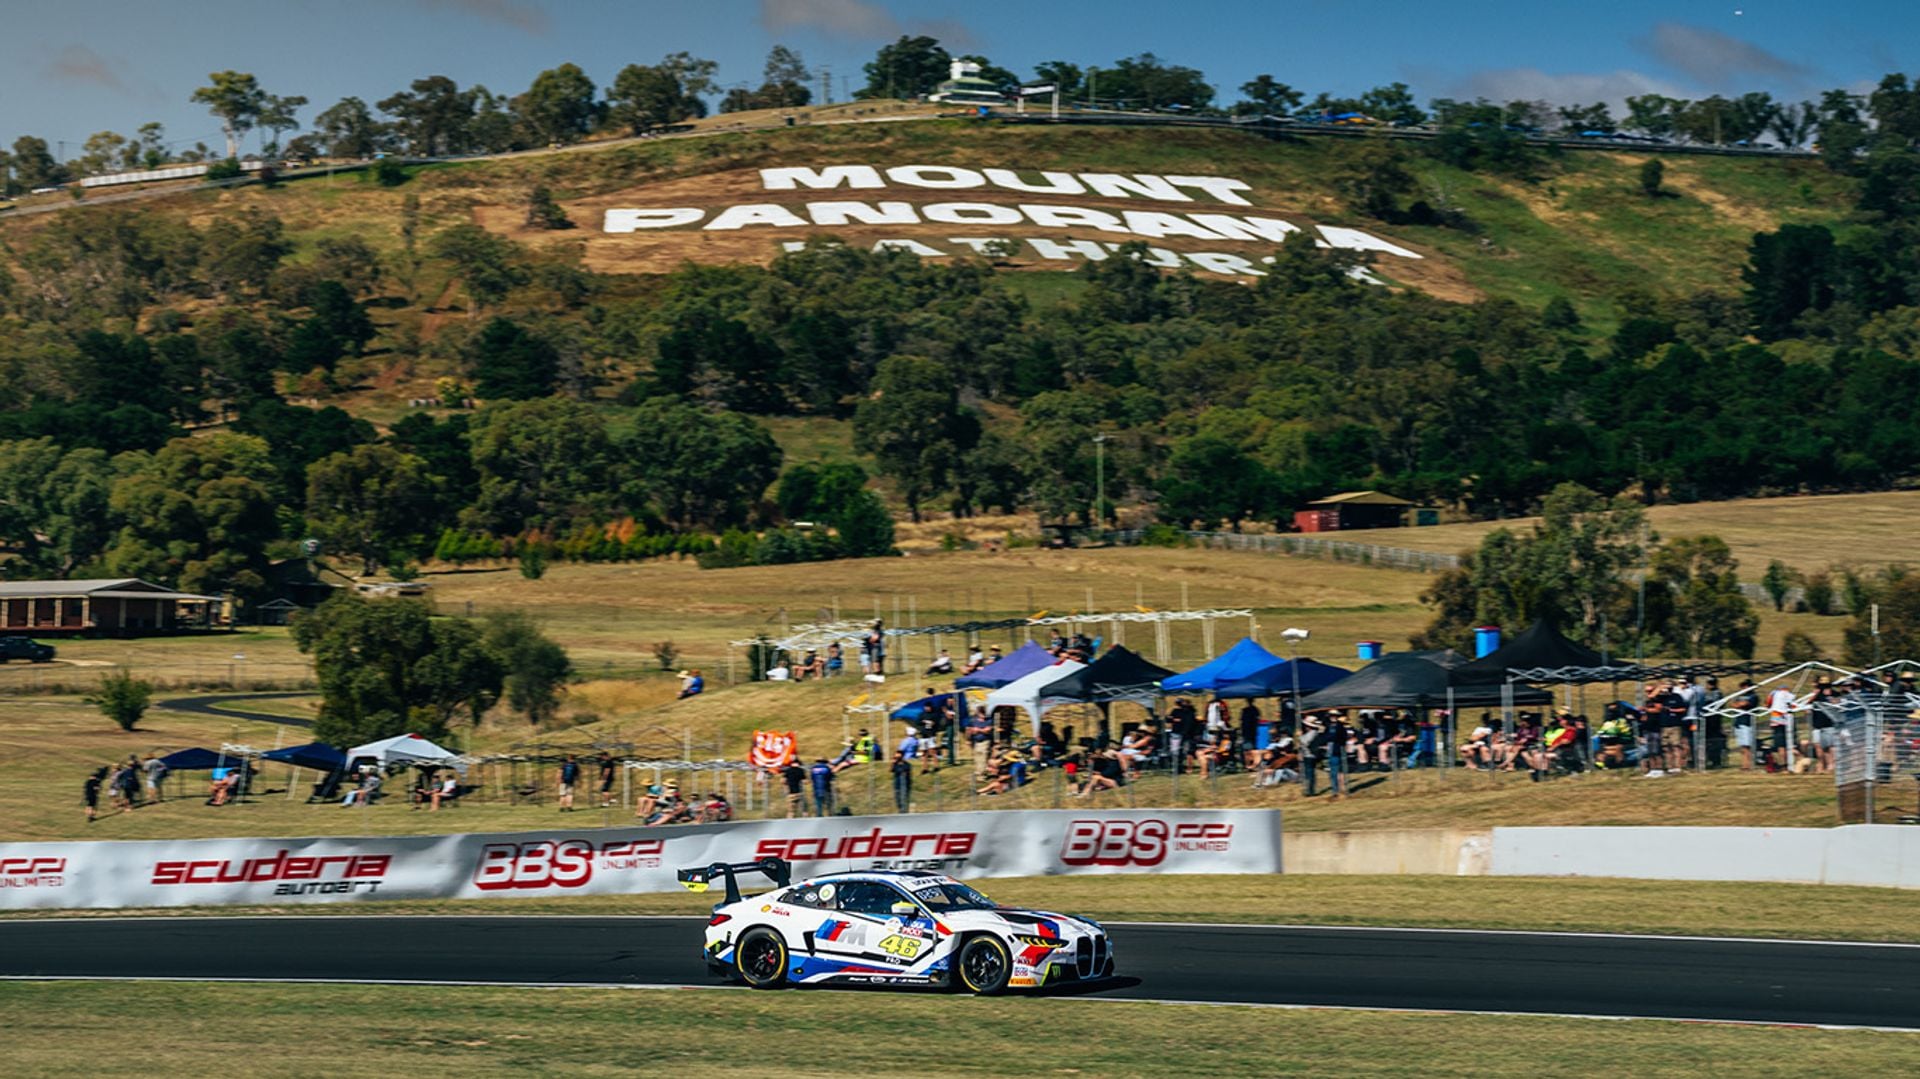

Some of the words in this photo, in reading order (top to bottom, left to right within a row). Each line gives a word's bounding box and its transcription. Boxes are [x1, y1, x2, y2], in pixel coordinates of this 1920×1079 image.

[759, 165, 1254, 206] MOUNT
[603, 201, 1424, 259] PANORAMA
[754, 828, 978, 861] scuderia
[1061, 819, 1169, 866] BBS
[1173, 841, 1230, 851] UNLIMITED
[151, 850, 393, 884] scuderia
[473, 839, 594, 890] BBS
[602, 857, 661, 869] UNLIMITED
[871, 857, 970, 871] autoart
[274, 881, 383, 896] autoart
[879, 933, 922, 958] 46
[886, 956, 901, 965] PRO
